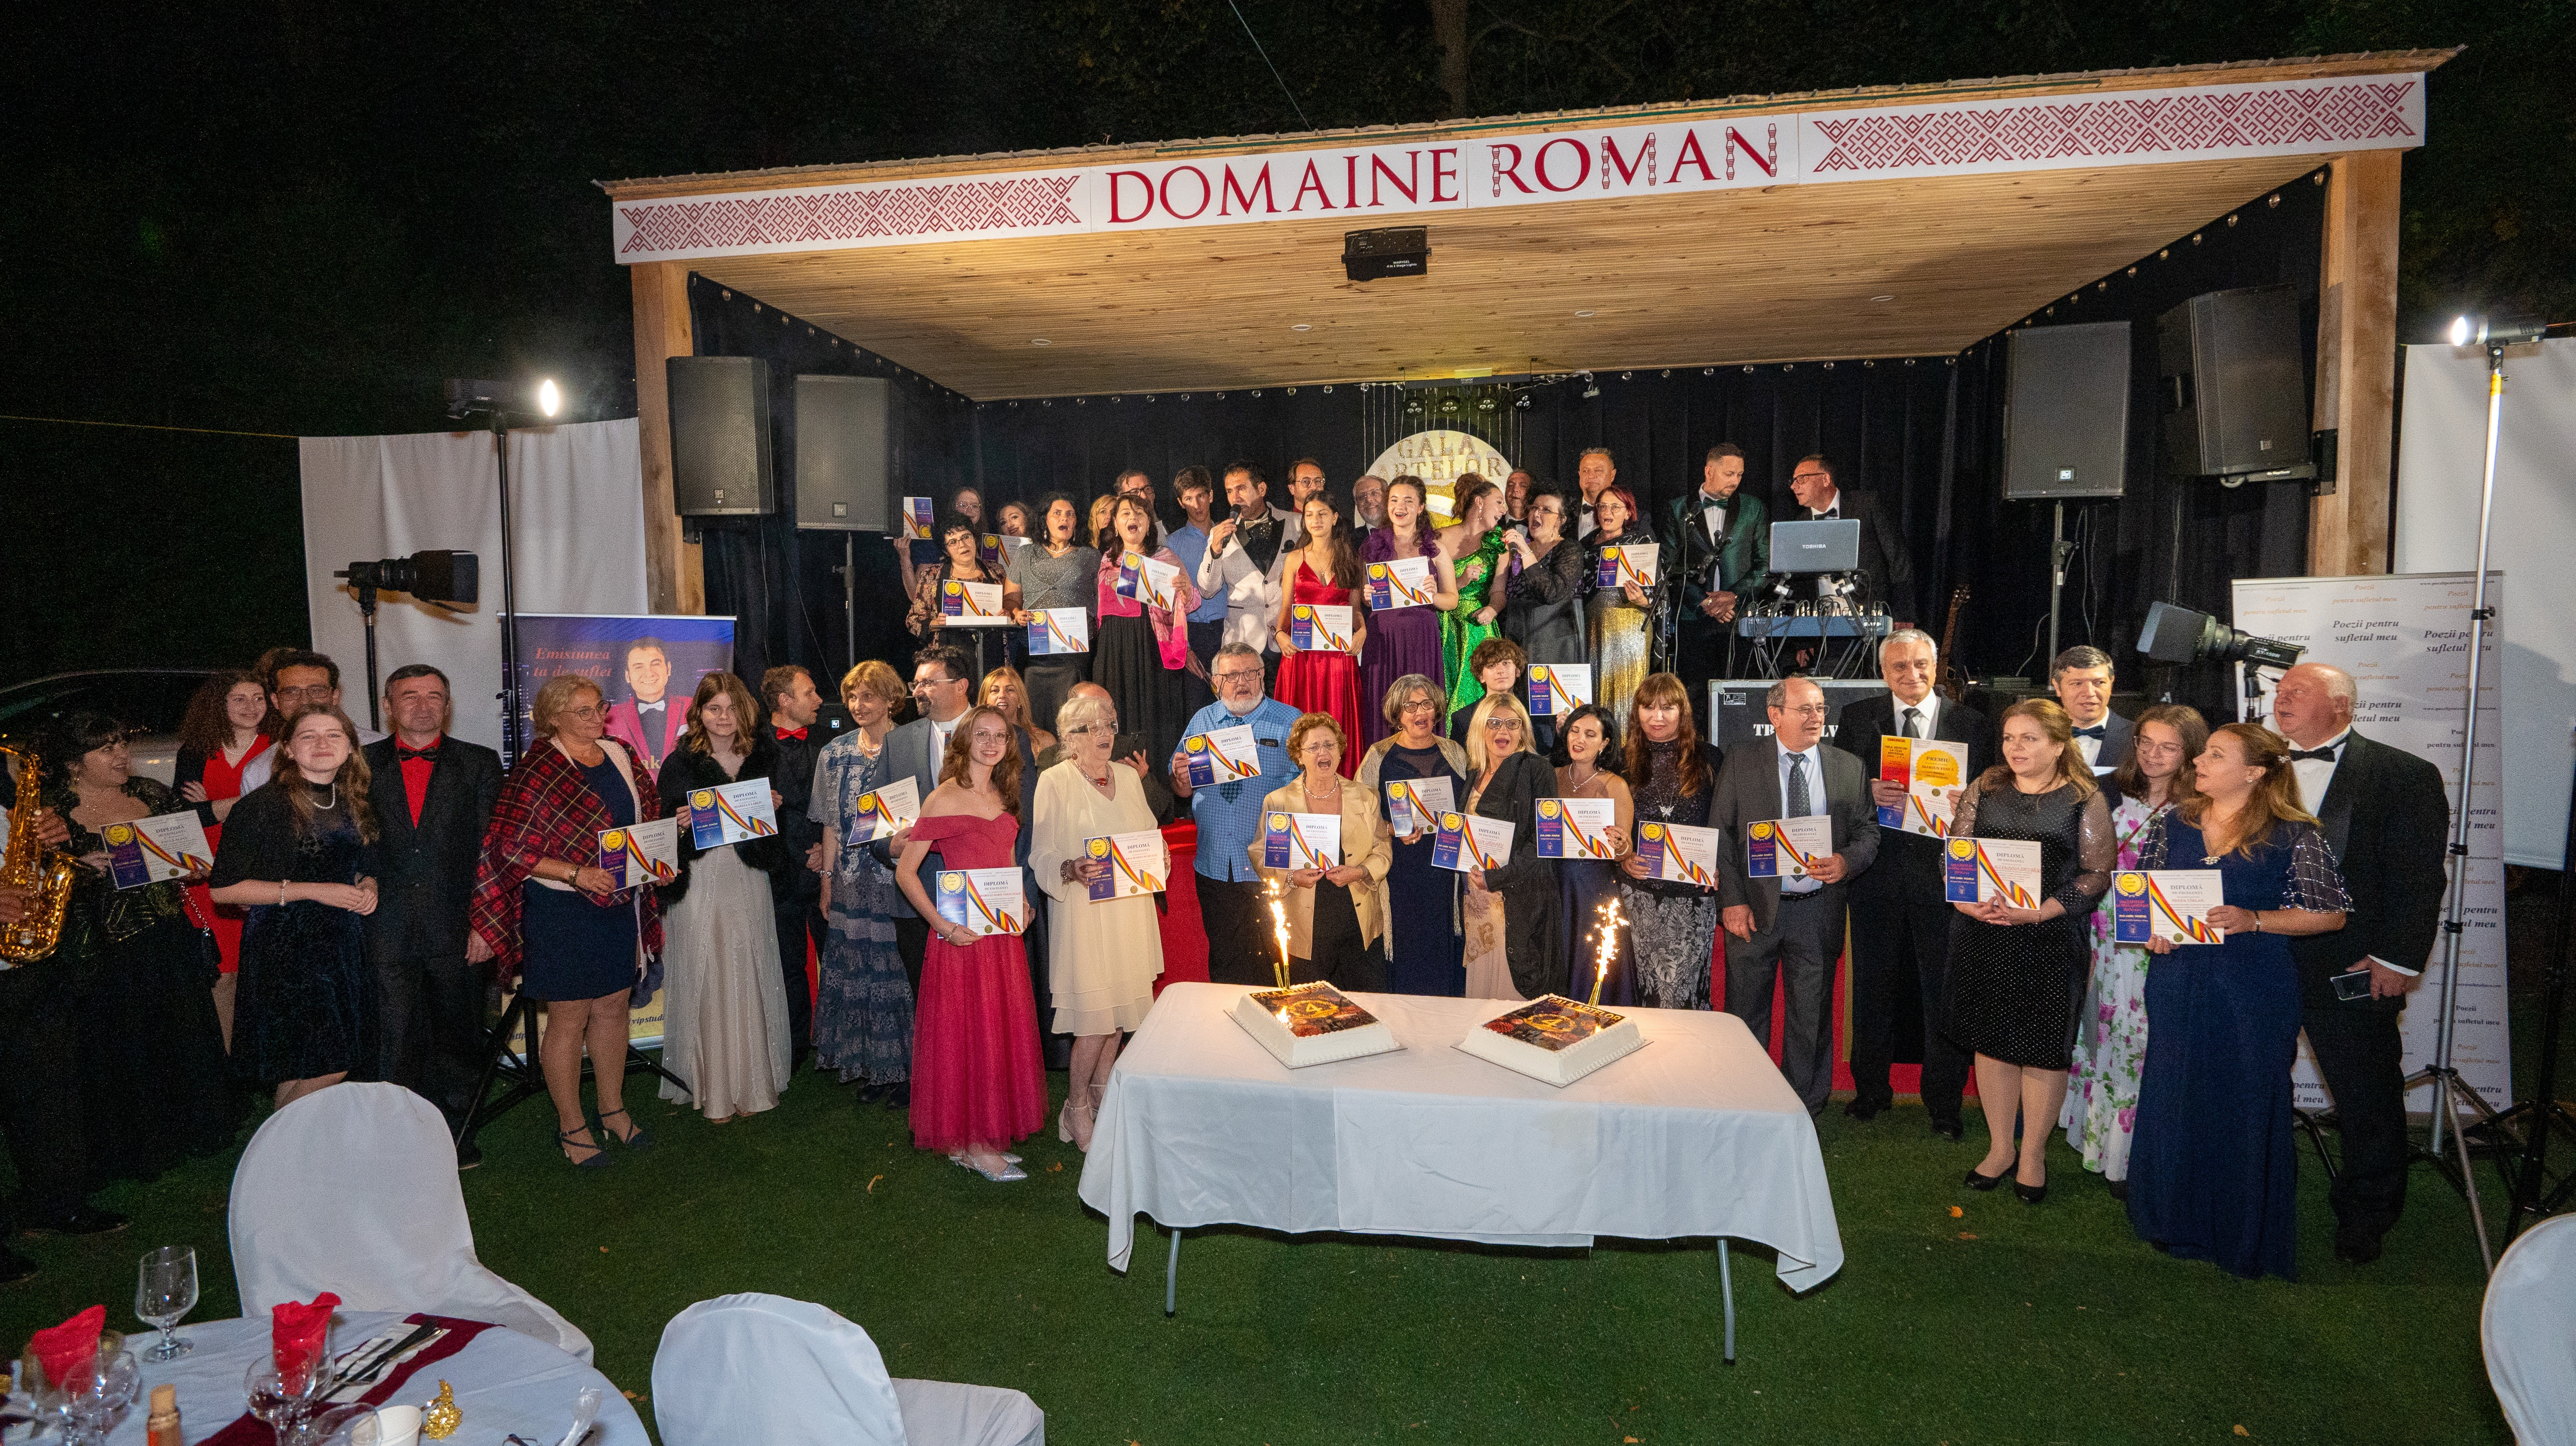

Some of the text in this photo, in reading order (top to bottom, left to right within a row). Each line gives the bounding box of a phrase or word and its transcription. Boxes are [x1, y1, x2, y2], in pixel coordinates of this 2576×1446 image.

[1105, 123, 1777, 223] DOMAINE ROMAN
[1398, 436, 1475, 459] GALA
[1378, 458, 1502, 480] ARTELOR
[2365, 621, 2399, 629] pentru
[2335, 633, 2374, 644] sufletul
[2424, 630, 2493, 639] Poezii peru
[536, 648, 610, 660] Emisiunea
[2426, 644, 2467, 654] sufletul
[533, 668, 547, 676] ta
[552, 665, 569, 676] de
[2368, 702, 2402, 710] pentru
[2464, 906, 2498, 915] pentru
[1281, 984, 1325, 995] ARTELOR
[1306, 1003, 1322, 1012] 4
[1548, 998, 1621, 1021] GALA ARTELOR
